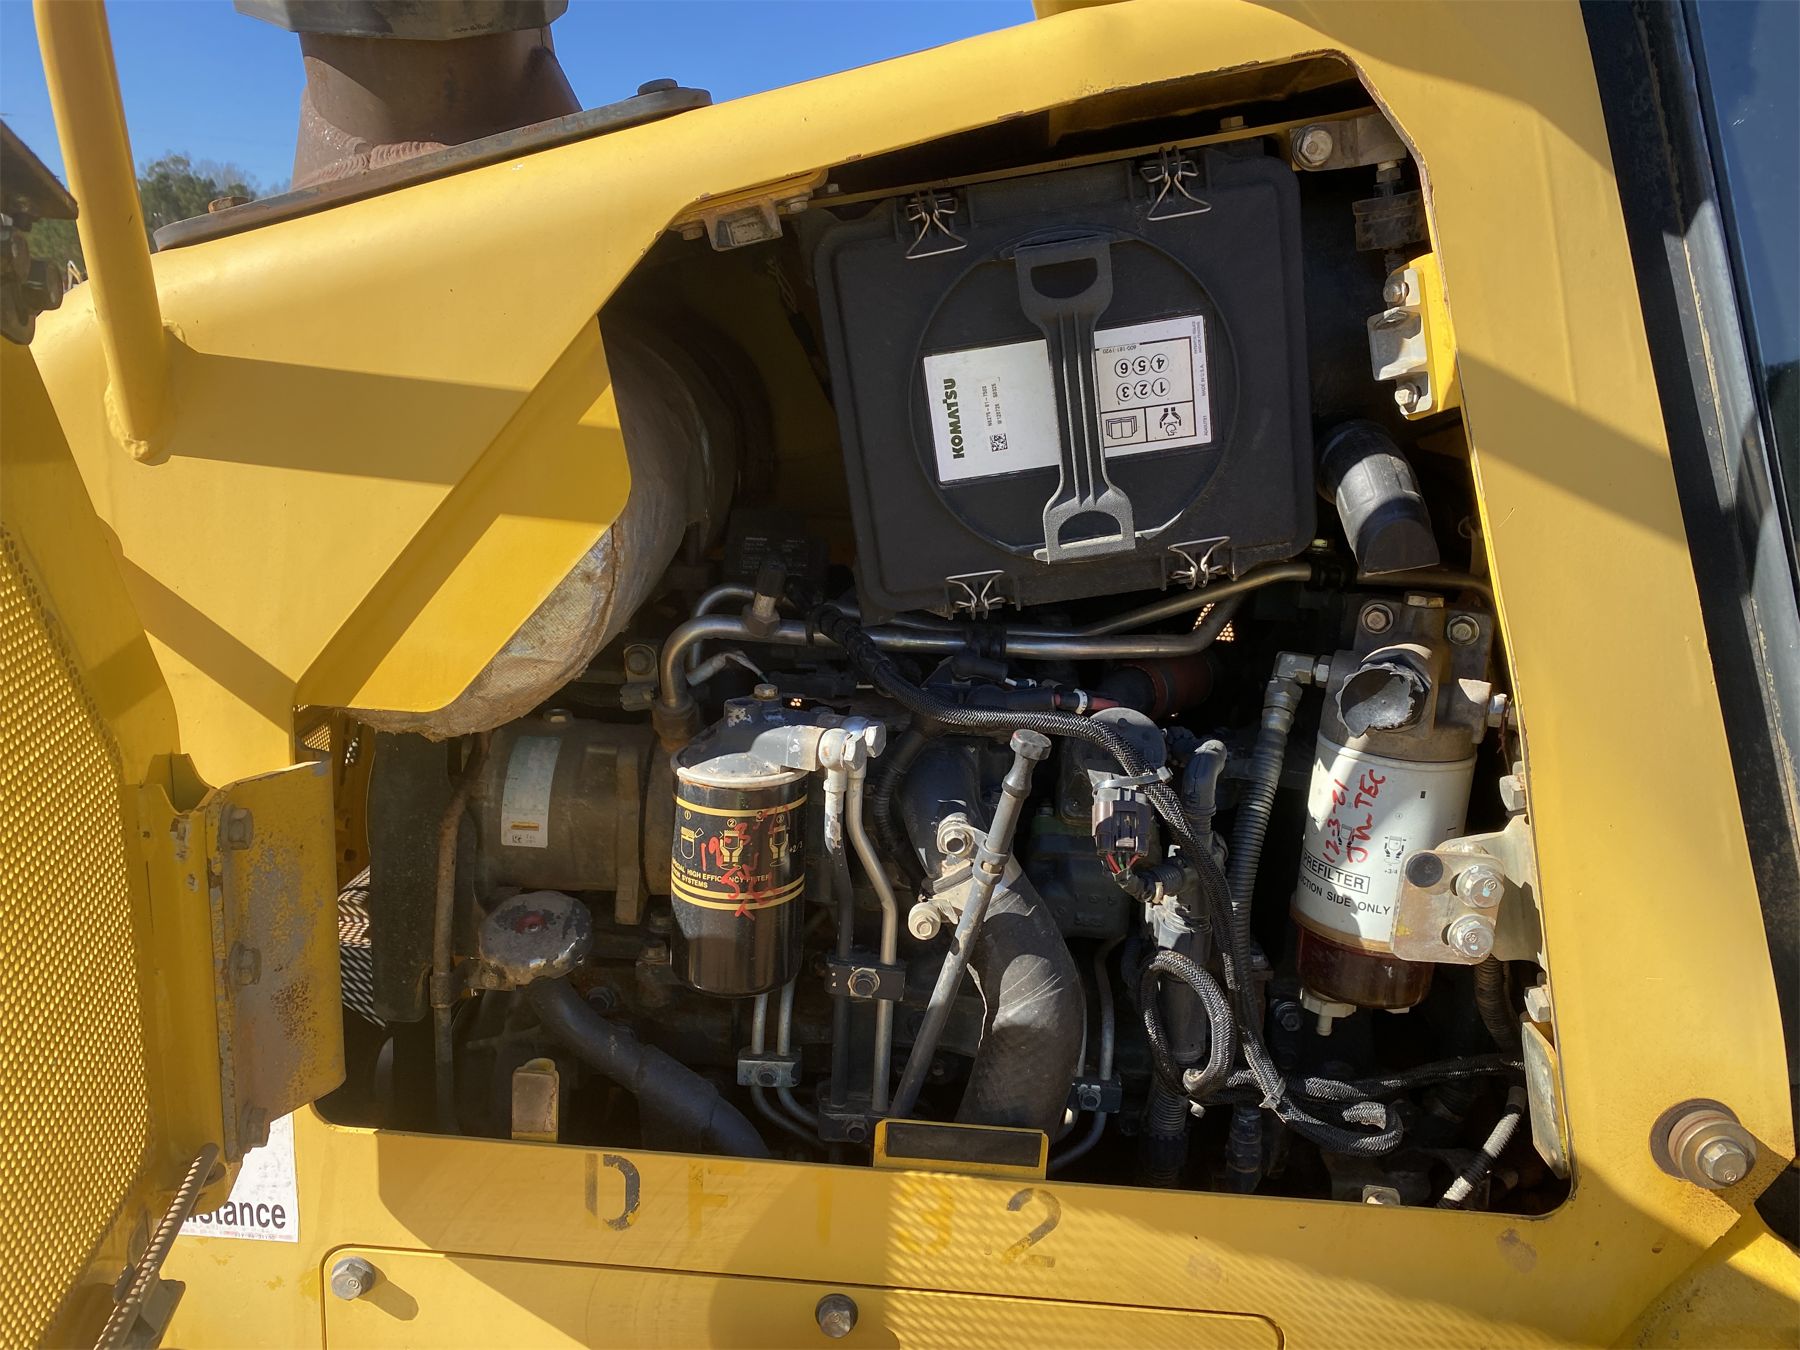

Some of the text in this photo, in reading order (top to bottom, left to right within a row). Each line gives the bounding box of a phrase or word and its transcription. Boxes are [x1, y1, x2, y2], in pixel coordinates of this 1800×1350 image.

[943, 378, 965, 459] KOMATSU
[1327, 891, 1351, 907] SIDE
[1358, 901, 1391, 915] ONLY
